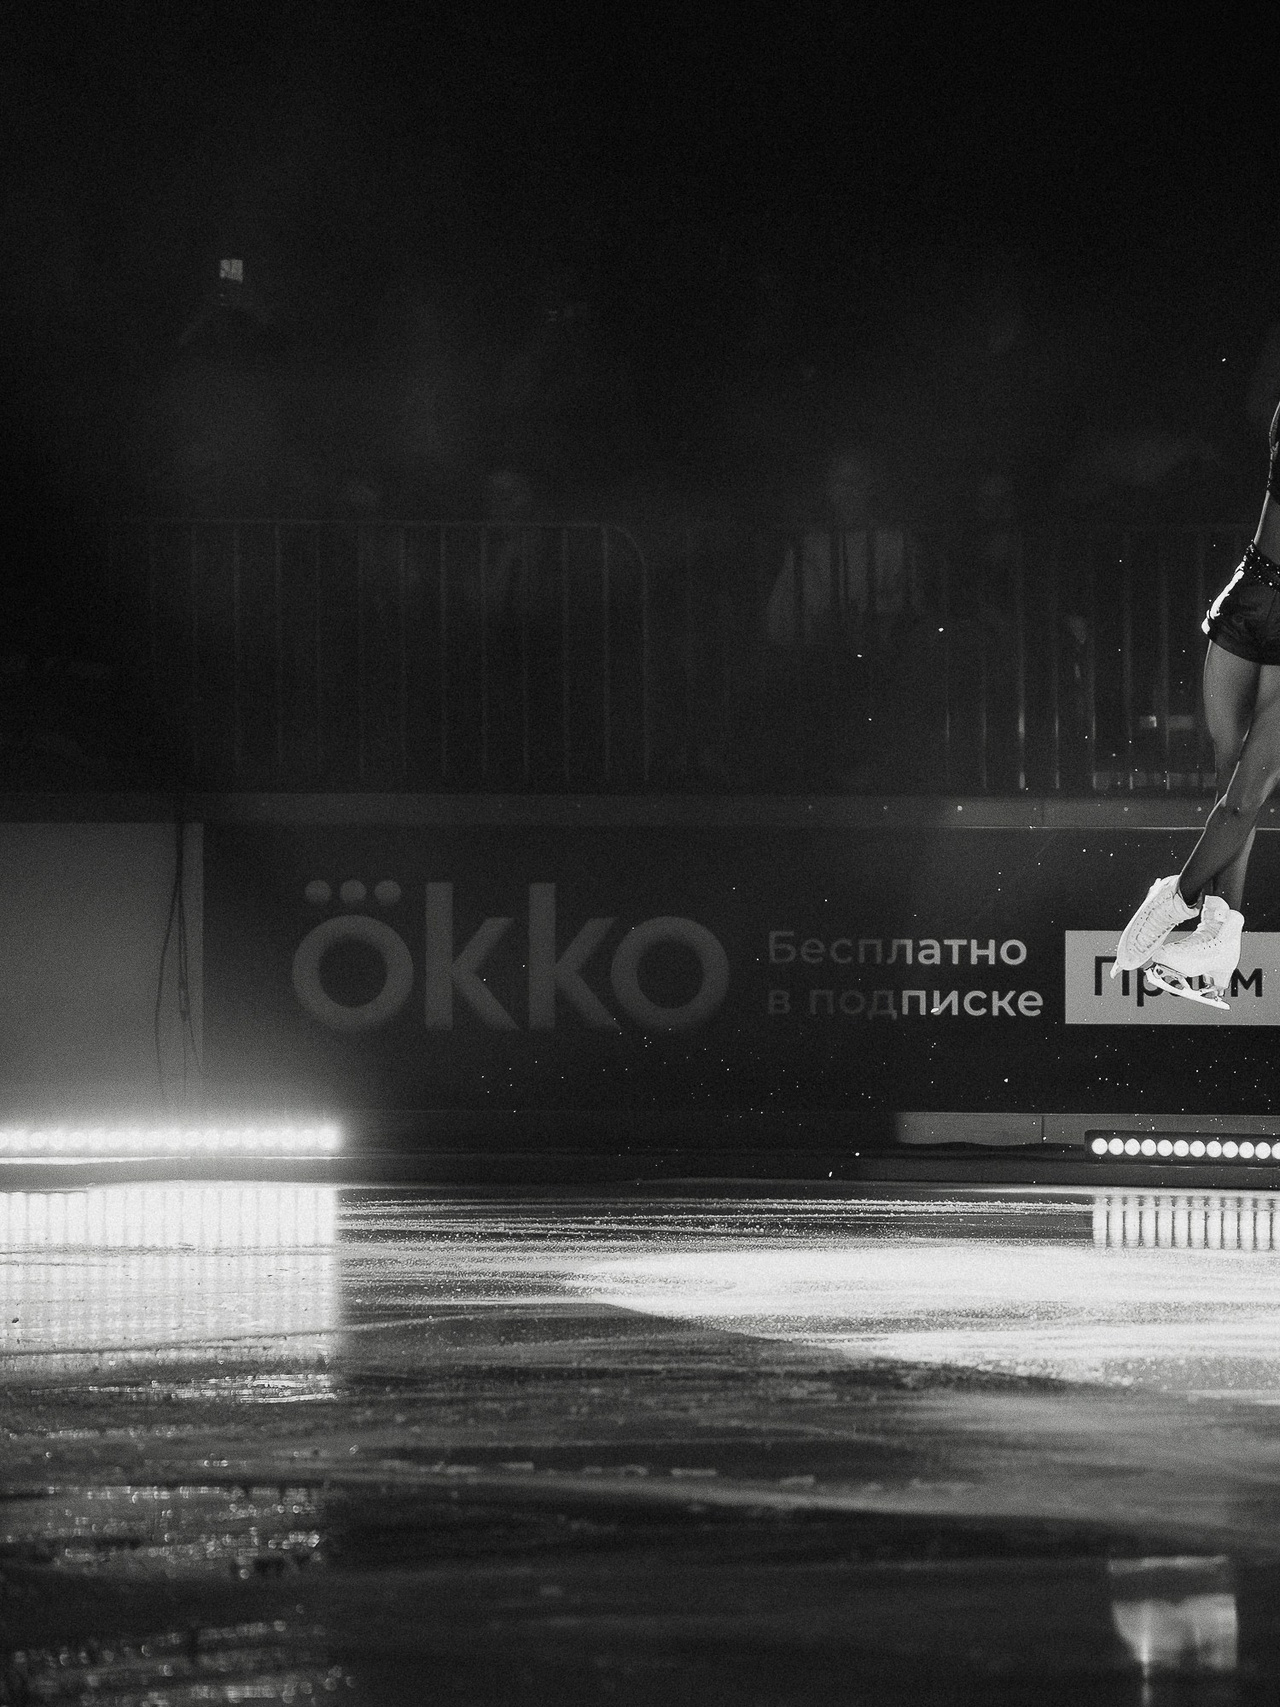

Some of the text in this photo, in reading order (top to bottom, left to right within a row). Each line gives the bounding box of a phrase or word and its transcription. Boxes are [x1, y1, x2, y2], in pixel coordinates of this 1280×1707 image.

[769, 932, 1027, 966] Бесплатно
[769, 989, 1044, 1019] в подписке
